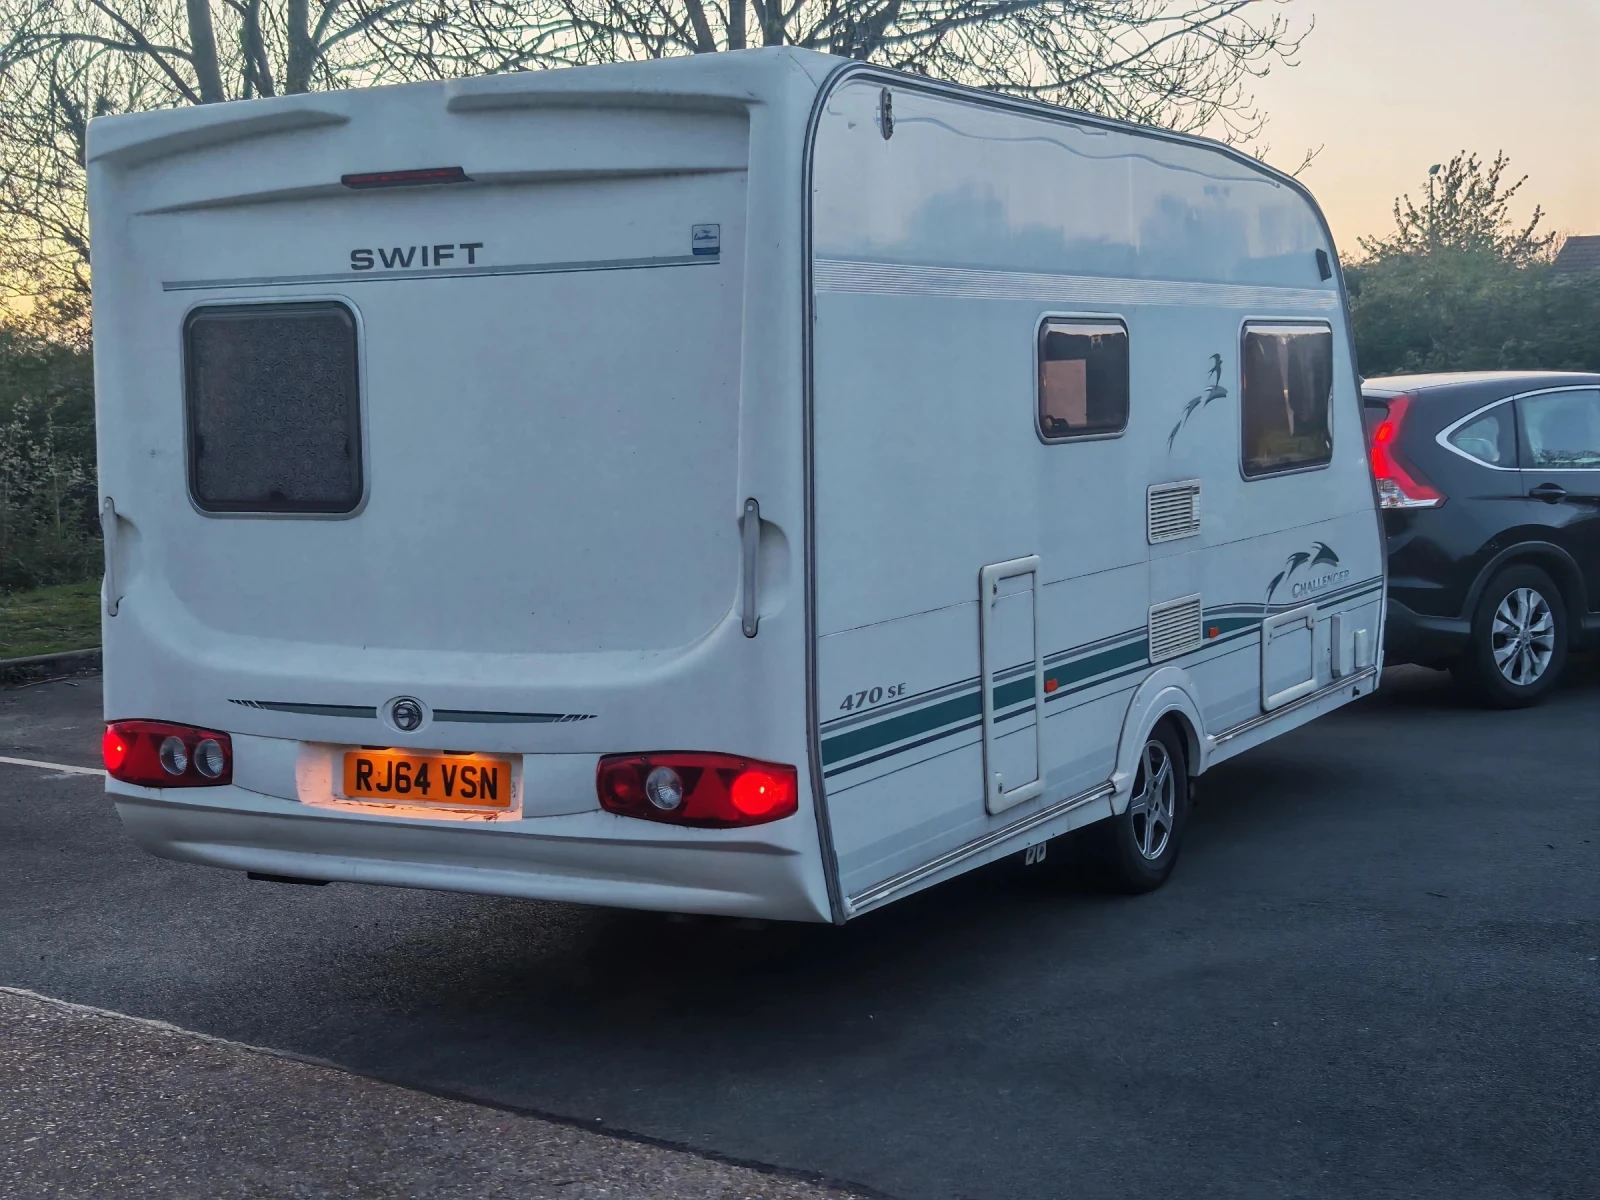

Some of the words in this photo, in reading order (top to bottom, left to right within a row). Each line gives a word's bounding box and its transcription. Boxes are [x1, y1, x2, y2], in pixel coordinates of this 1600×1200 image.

[350, 243, 484, 271] SWIFT
[839, 686, 883, 711] 470
[887, 682, 906, 699] SE
[356, 758, 431, 796] RJ64
[441, 764, 498, 800] VSN
